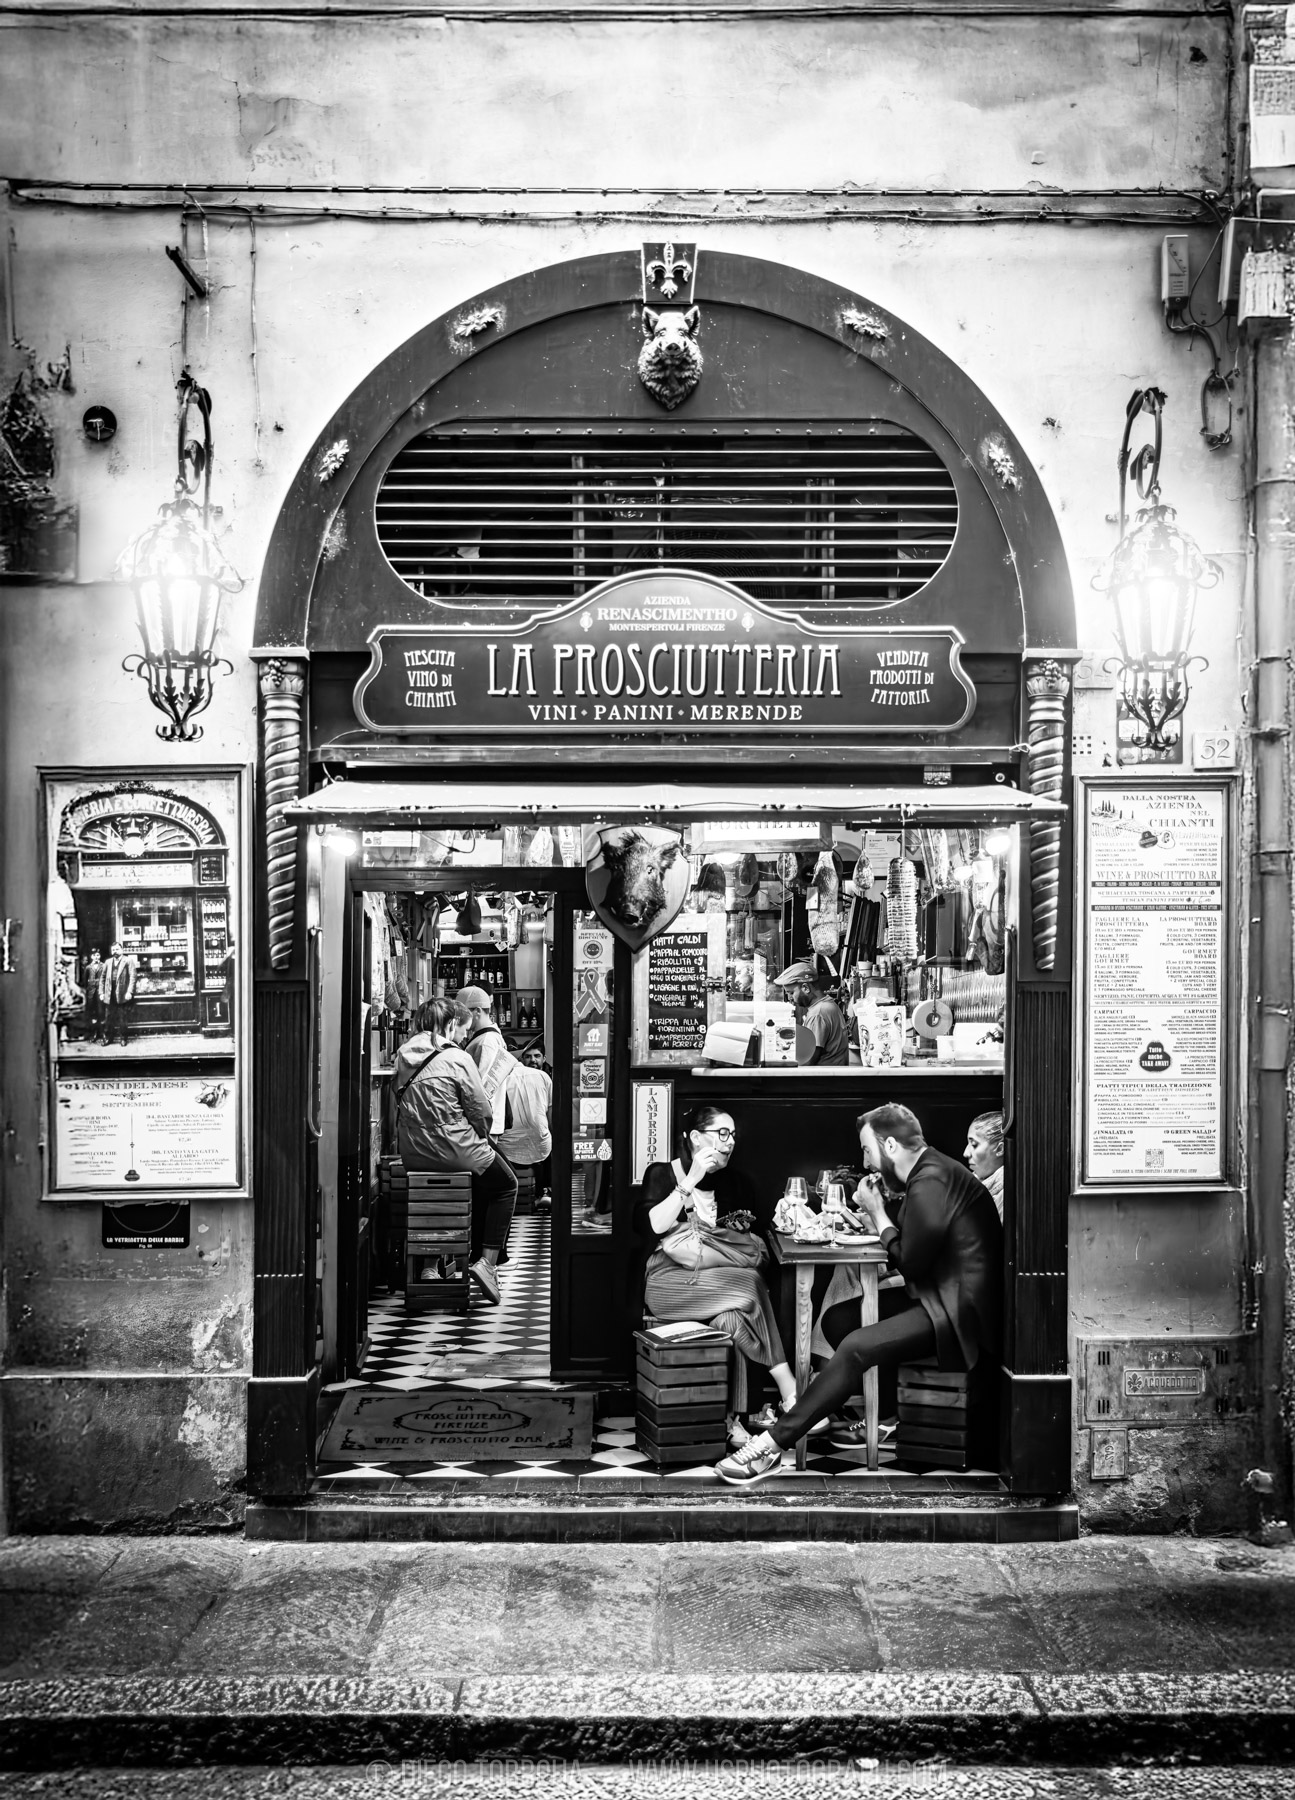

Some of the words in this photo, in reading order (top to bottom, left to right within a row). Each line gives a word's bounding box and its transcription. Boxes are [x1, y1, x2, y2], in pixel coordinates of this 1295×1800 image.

[644, 596, 691, 606] AZIENDA
[597, 608, 738, 622] RENASCIMENTHO
[609, 623, 684, 632] MONTESPERTOLI
[686, 623, 726, 632] FIRENZE
[404, 649, 455, 667] MESCITA
[877, 650, 929, 667] VENDITA
[487, 643, 537, 696] LA
[552, 642, 842, 696] PROSCIUTTERIA
[407, 671, 438, 687] VINO
[442, 674, 452, 687] DI
[870, 670, 921, 685] PRODOTTI
[925, 672, 934, 685] DI
[405, 690, 456, 707] CHIANTI
[871, 688, 930, 706] FATTORIA
[528, 705, 577, 720] VINI
[594, 705, 673, 720] PANINI
[690, 705, 803, 720] MERENDE
[1200, 738, 1230, 759] 52
[1149, 819, 1214, 827] CHIANTI
[1097, 871, 1123, 879] WINE
[1126, 871, 1131, 879] &
[1134, 870, 1196, 879] PROSCIUTTO
[1199, 871, 1217, 879] BAR
[677, 934, 701, 944] CALDI
[657, 958, 691, 966] RIBOLLITA
[124, 1082, 149, 1090] DEL
[646, 1088, 658, 1165] LAMPREDOT
[1143, 1377, 1196, 1388] ACQUEDOTTO
[414, 1412, 512, 1420] PROSCIUTTERIA
[434, 1421, 488, 1429] FIRENZE
[430, 1436, 509, 1444] PROSCIUTTO
[1105, 1445, 1115, 1461] GAS
